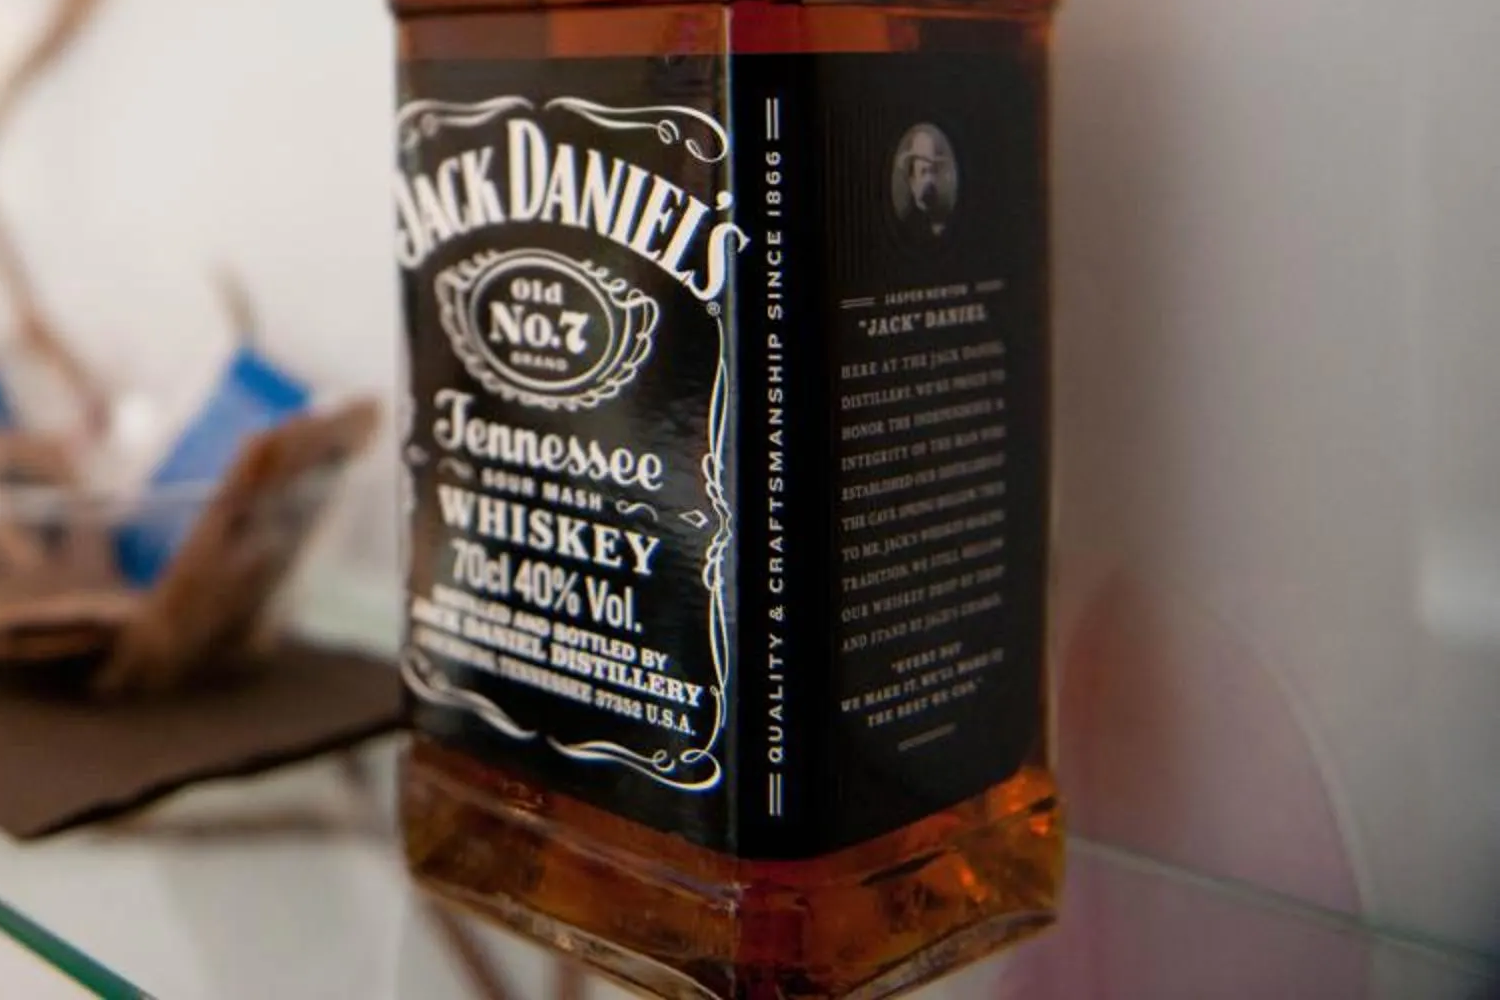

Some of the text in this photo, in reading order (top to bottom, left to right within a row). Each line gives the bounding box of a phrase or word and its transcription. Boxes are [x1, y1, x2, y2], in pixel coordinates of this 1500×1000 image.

[393, 118, 750, 300] JACK DANIEL'S
[510, 277, 563, 305] Old
[489, 301, 589, 354] No.7
[510, 351, 568, 371] BRAND
[433, 388, 663, 491] Tennessee
[766, 151, 784, 763] QUALITY & CRAFTSMANSHIP SINCE 1866
[542, 481, 602, 511] MASH
[437, 483, 660, 576] WHISKEY
[450, 537, 510, 595] 70cl
[514, 559, 581, 616] 40%
[585, 575, 643, 632] Vol.
[553, 621, 636, 662] BOTTLED
[641, 647, 669, 670] BY
[550, 643, 703, 707] DISTILLERY
[645, 702, 697, 736] U.S.A.
